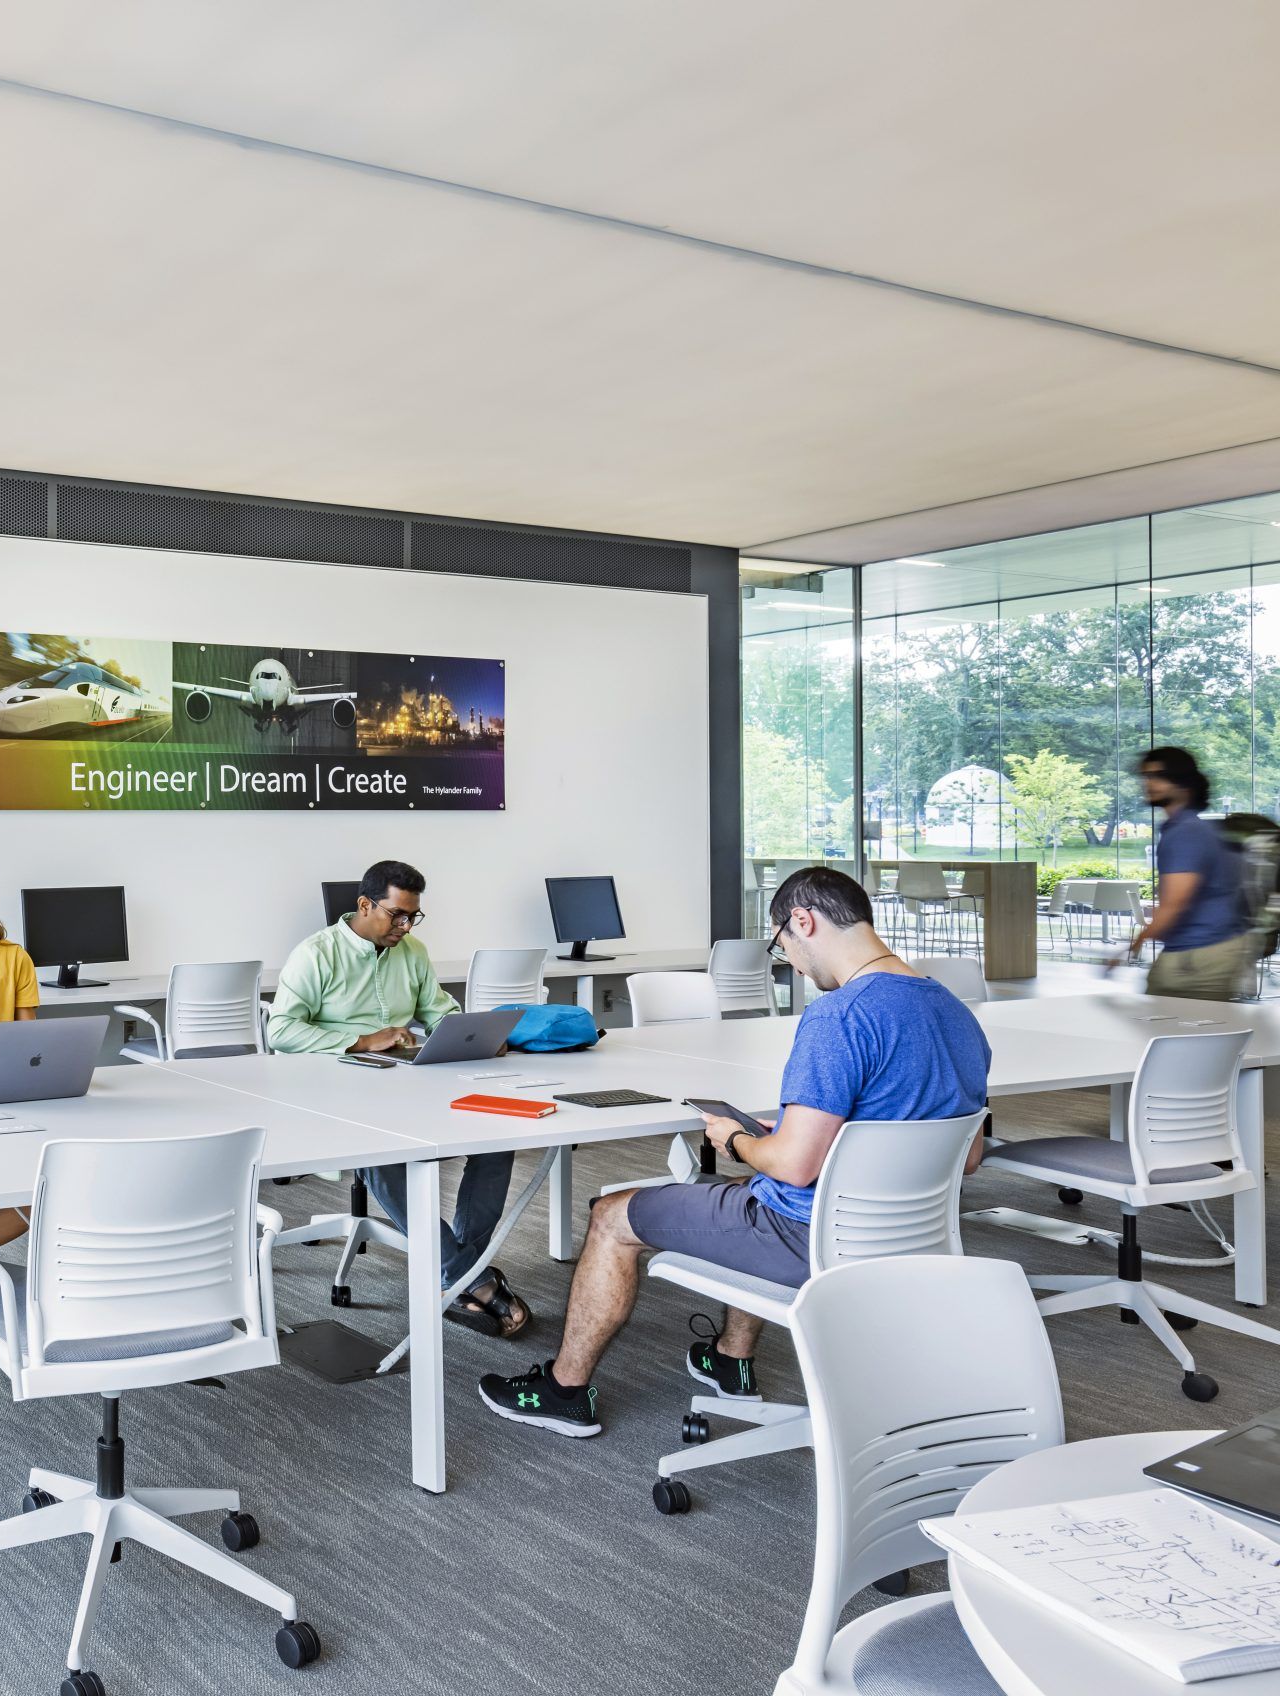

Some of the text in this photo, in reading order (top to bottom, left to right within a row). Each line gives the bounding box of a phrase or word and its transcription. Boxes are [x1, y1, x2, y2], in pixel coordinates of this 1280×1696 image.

[71, 762, 198, 800] Engineer
[220, 764, 307, 793] Dream
[328, 766, 407, 794] Create
[422, 786, 482, 796] The Hylander Family
